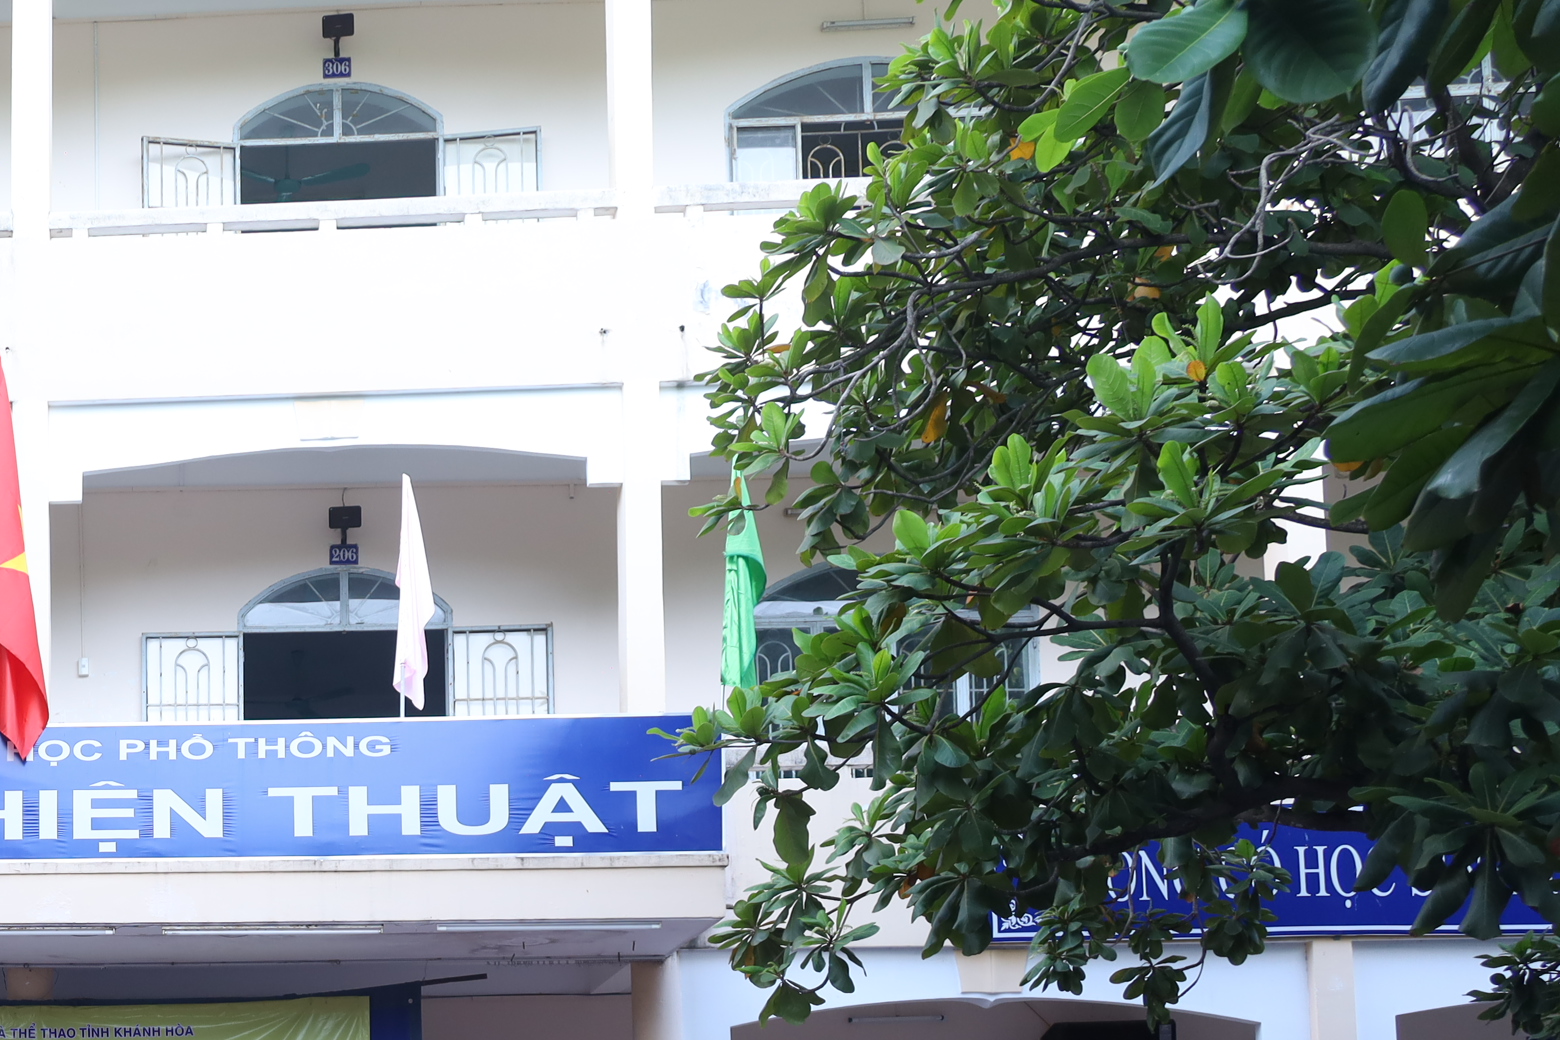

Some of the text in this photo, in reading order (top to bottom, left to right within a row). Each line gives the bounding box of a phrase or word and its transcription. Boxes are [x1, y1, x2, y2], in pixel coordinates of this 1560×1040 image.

[325, 61, 349, 75] 306
[332, 548, 357, 561] 206
[7, 739, 103, 767] HỌC
[119, 733, 214, 761] PHỔ
[228, 731, 391, 759] THÔNG
[267, 774, 682, 847] THUẬT
[11, 1023, 35, 1038] THỂ
[41, 1028, 76, 1038] THAO
[79, 1024, 109, 1038] TỈNH
[115, 1023, 161, 1037] KHÁNH
[165, 1023, 194, 1037] HÒA
